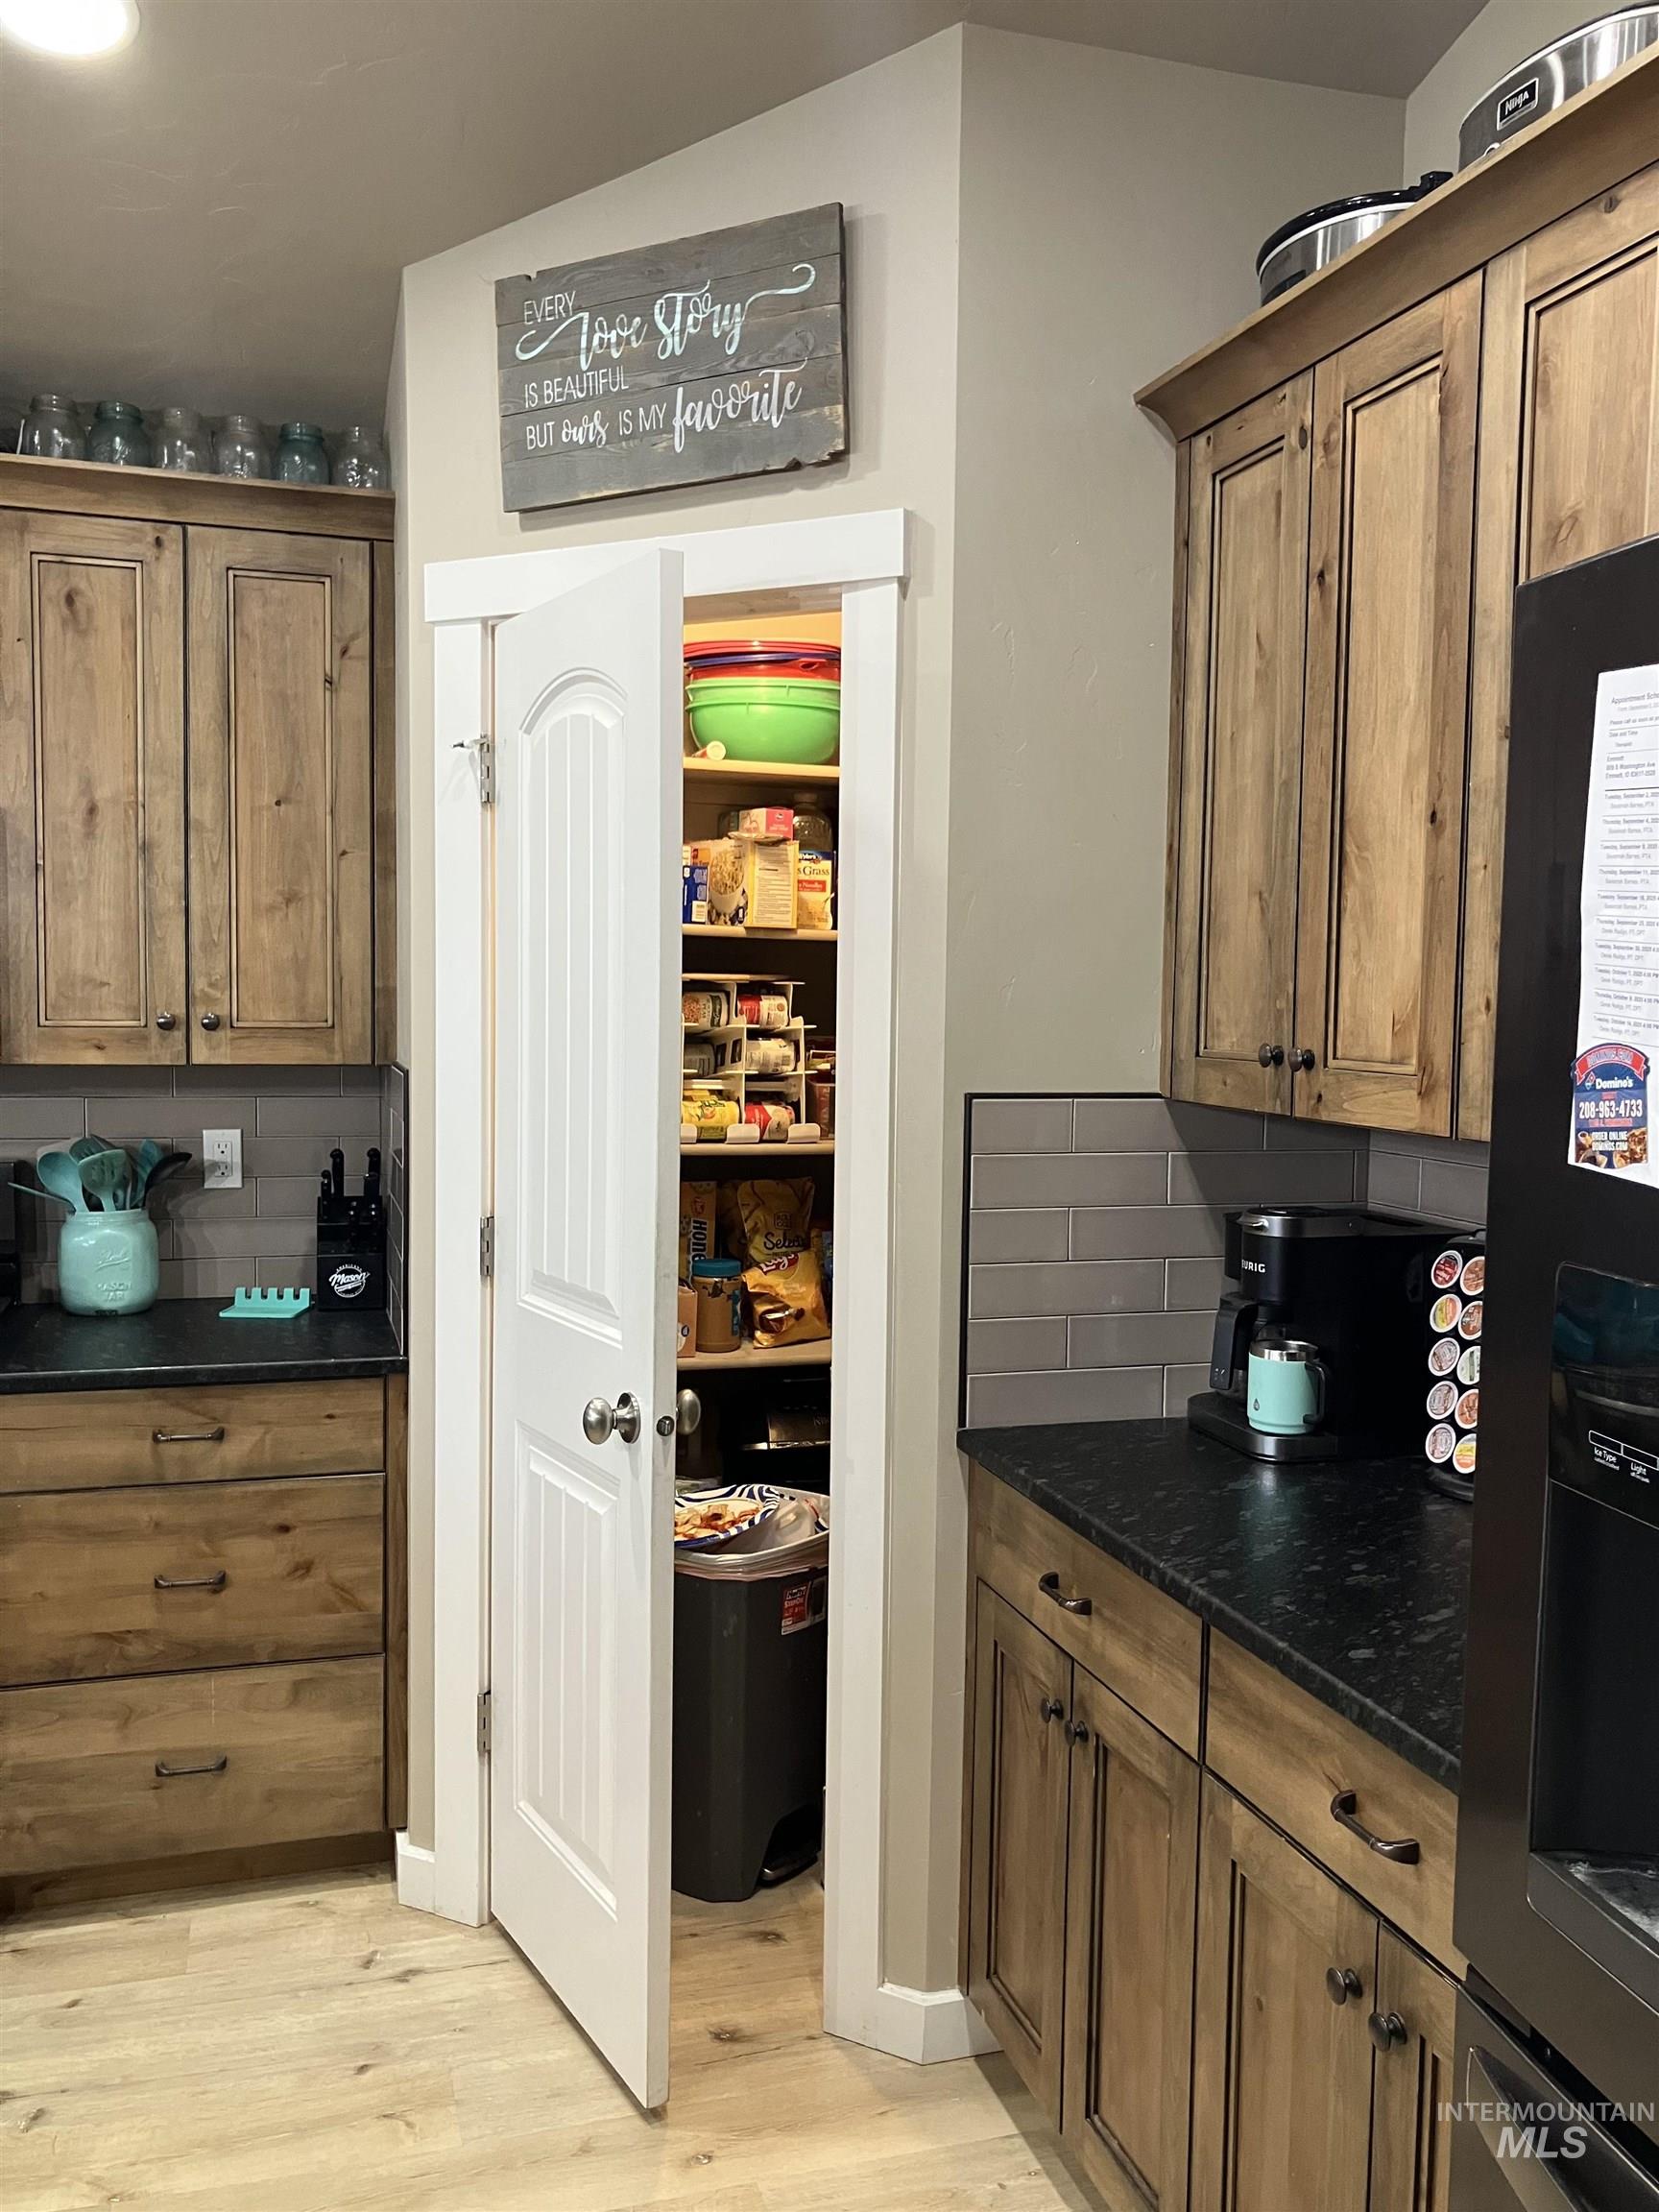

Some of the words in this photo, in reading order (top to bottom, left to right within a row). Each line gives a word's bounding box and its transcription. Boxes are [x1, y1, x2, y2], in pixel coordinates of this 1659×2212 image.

[523, 290, 577, 325] EVERY
[524, 384, 538, 408] IS
[543, 365, 629, 404] BEAUTIFUL
[526, 421, 555, 450] BUT
[562, 410, 610, 448] ours
[618, 411, 632, 436] IS
[638, 402, 667, 433] MY
[671, 357, 808, 453] favorite
[803, 865, 830, 877] Grass
[1595, 1075, 1634, 1090] Domino's
[1579, 1099, 1643, 1119] 208-963-4733
